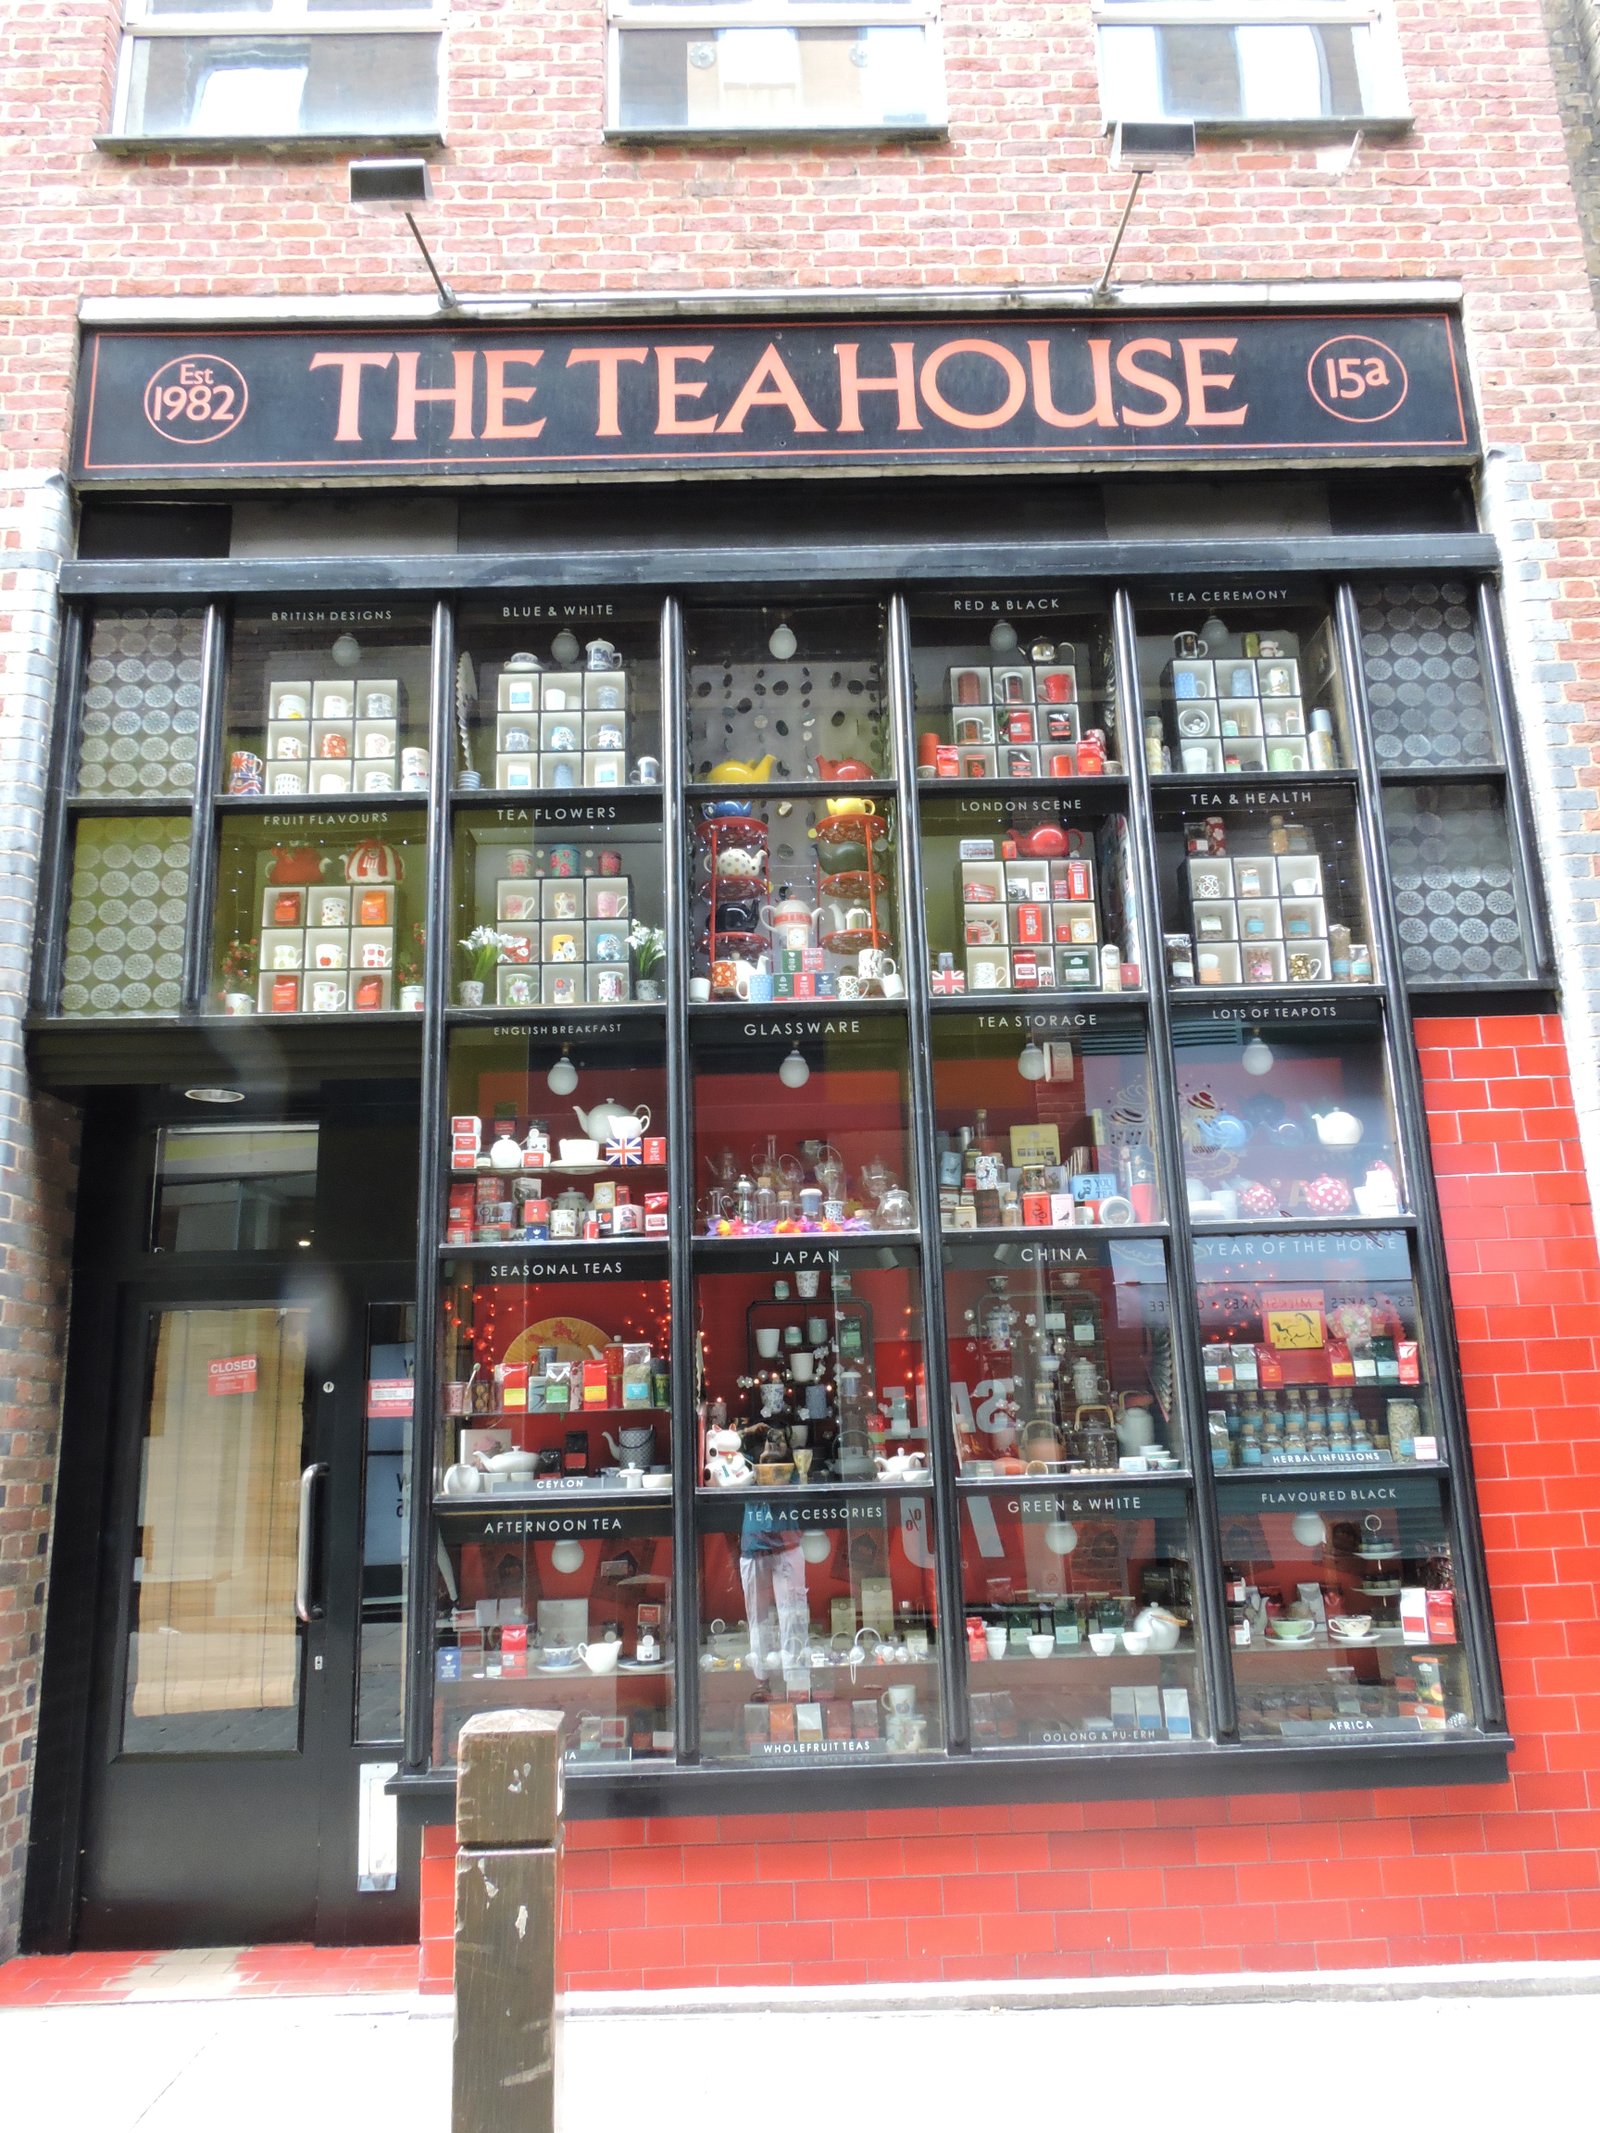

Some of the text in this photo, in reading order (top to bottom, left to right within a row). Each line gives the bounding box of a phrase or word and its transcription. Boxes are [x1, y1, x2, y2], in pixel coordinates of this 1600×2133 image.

[179, 363, 215, 386] Est
[1325, 356, 1391, 400] 15a
[308, 348, 548, 442] THE
[152, 386, 235, 423] 1982
[1169, 590, 1287, 602] TEA CEREMONY
[502, 605, 613, 618] BLUE & WHITE
[954, 599, 1060, 611] RED & BLACK
[271, 610, 392, 622] BRITISH DESIGNS
[1190, 792, 1312, 805] TEA & HEALTH
[961, 800, 1082, 812] LONDON SCENE
[263, 813, 388, 826] FRUIT FLAVOURS
[497, 807, 616, 821] TEA FLOWERS
[1212, 1007, 1337, 1020] LOTS OF TEAPOTS
[978, 1014, 1097, 1028] TEA STORAGE
[493, 1024, 622, 1036] ENGLISH BREAKFAST
[743, 1021, 860, 1036] GLASSWARE
[1205, 1243, 1254, 1256] YEAR
[1261, 1242, 1286, 1255] OF
[1292, 1240, 1326, 1254] THE
[1336, 1237, 1396, 1252] HORSE
[771, 1251, 840, 1265] JAPAN
[1020, 1248, 1088, 1262] CHINA
[490, 1262, 622, 1277] SEASONAL TEAS
[210, 1359, 257, 1374] CLOSED
[1272, 1451, 1380, 1464] HERBAL INFUSIONS
[536, 1480, 584, 1489] CEYLON
[1261, 1489, 1397, 1504] FLAVOURED BLACK
[1007, 1497, 1141, 1514] GREEN & WHITE
[748, 1507, 882, 1521] TEA ACCESSORIES
[484, 1519, 622, 1534] AFTERNOON TEA
[1328, 1721, 1374, 1731] AFRICA
[1042, 1732, 1097, 1743] OOLONG
[1112, 1730, 1155, 1740] PU-ERH
[763, 1741, 870, 1754] WHOLEFRUIT TEAS
